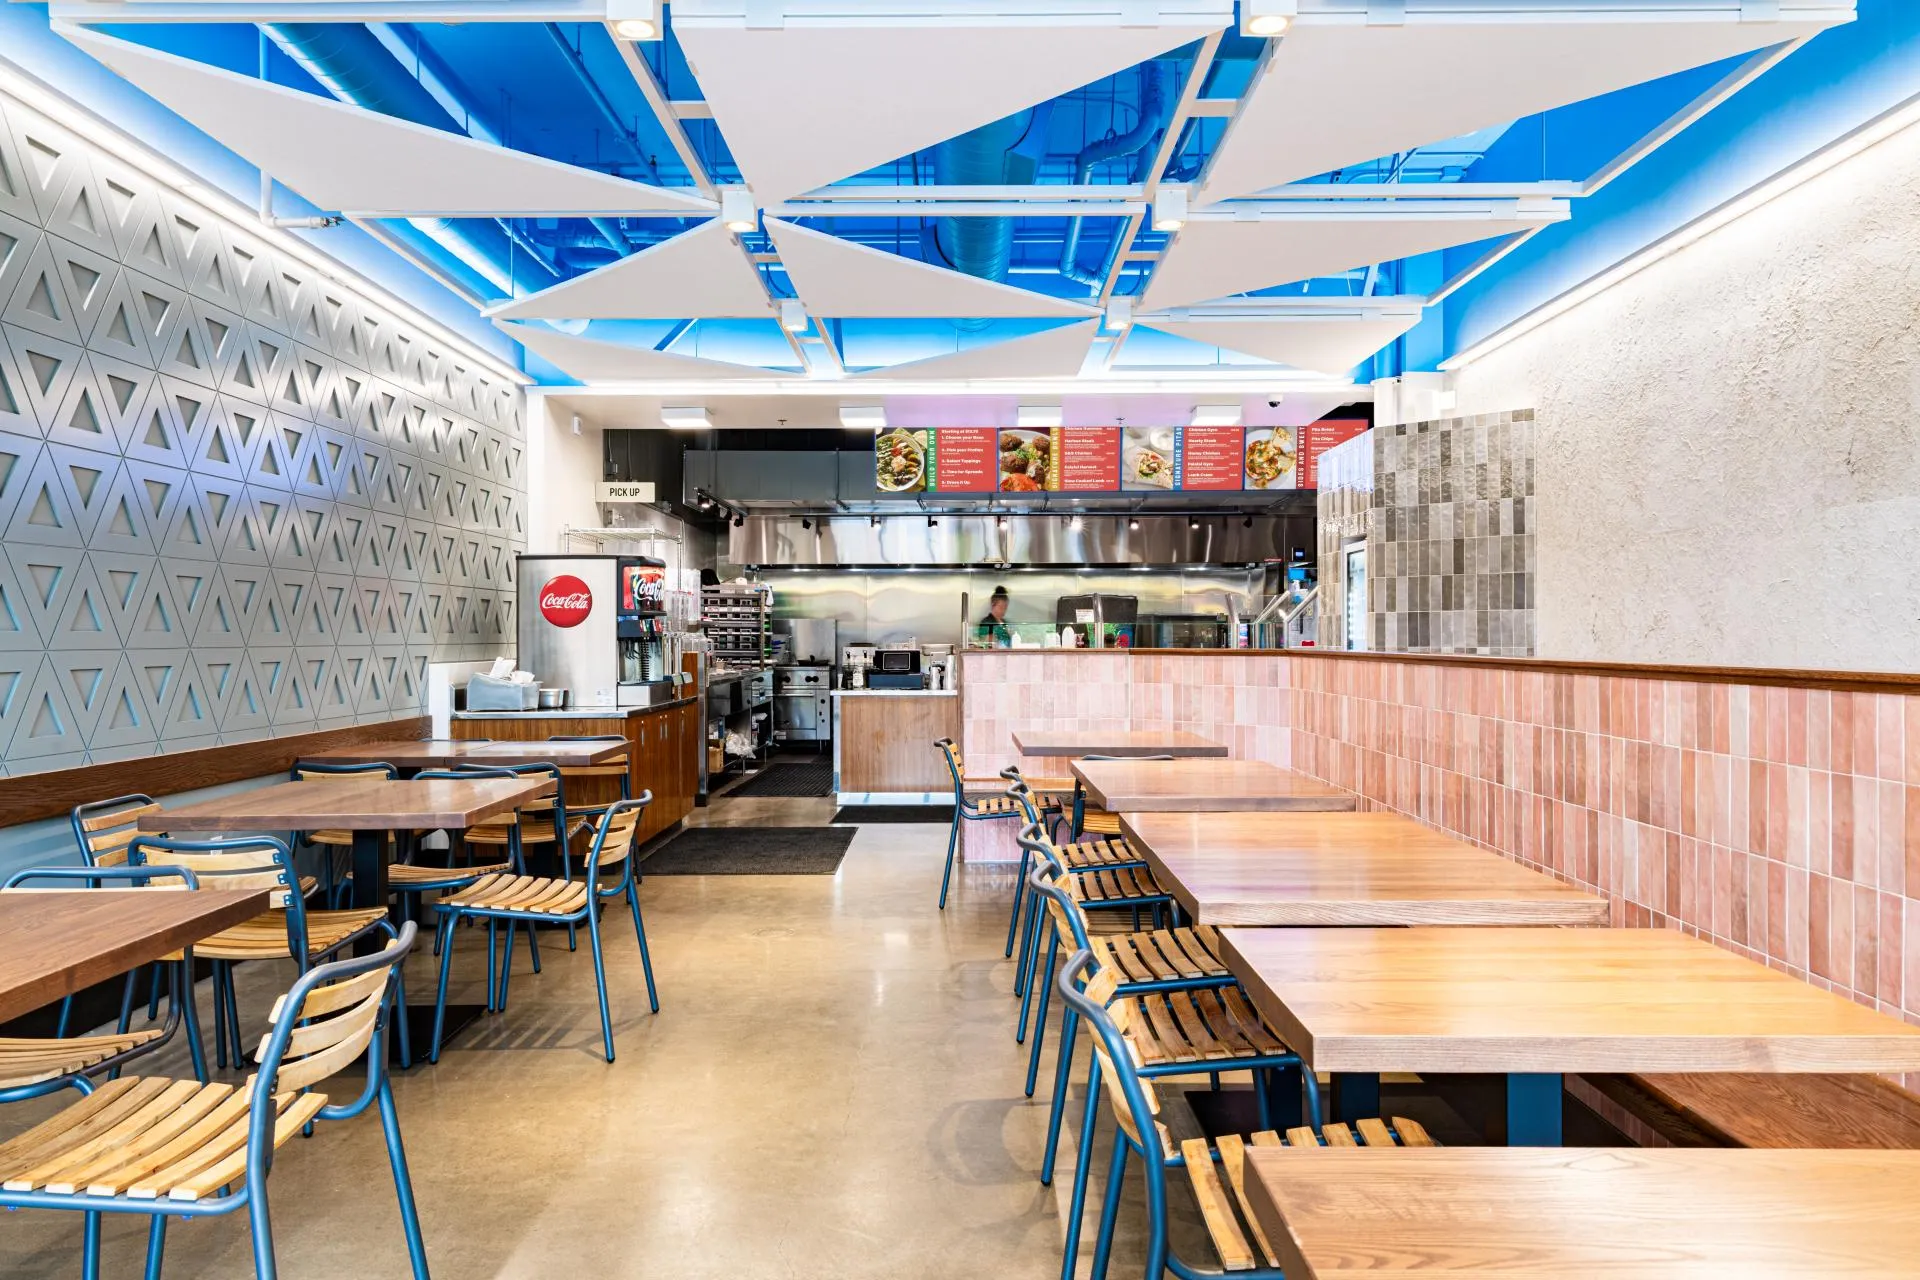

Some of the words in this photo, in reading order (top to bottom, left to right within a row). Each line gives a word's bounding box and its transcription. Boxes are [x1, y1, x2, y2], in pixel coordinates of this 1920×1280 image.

[610, 488, 628, 496] PICK
[629, 488, 640, 496] UP
[542, 592, 590, 609] Coca-Cola
